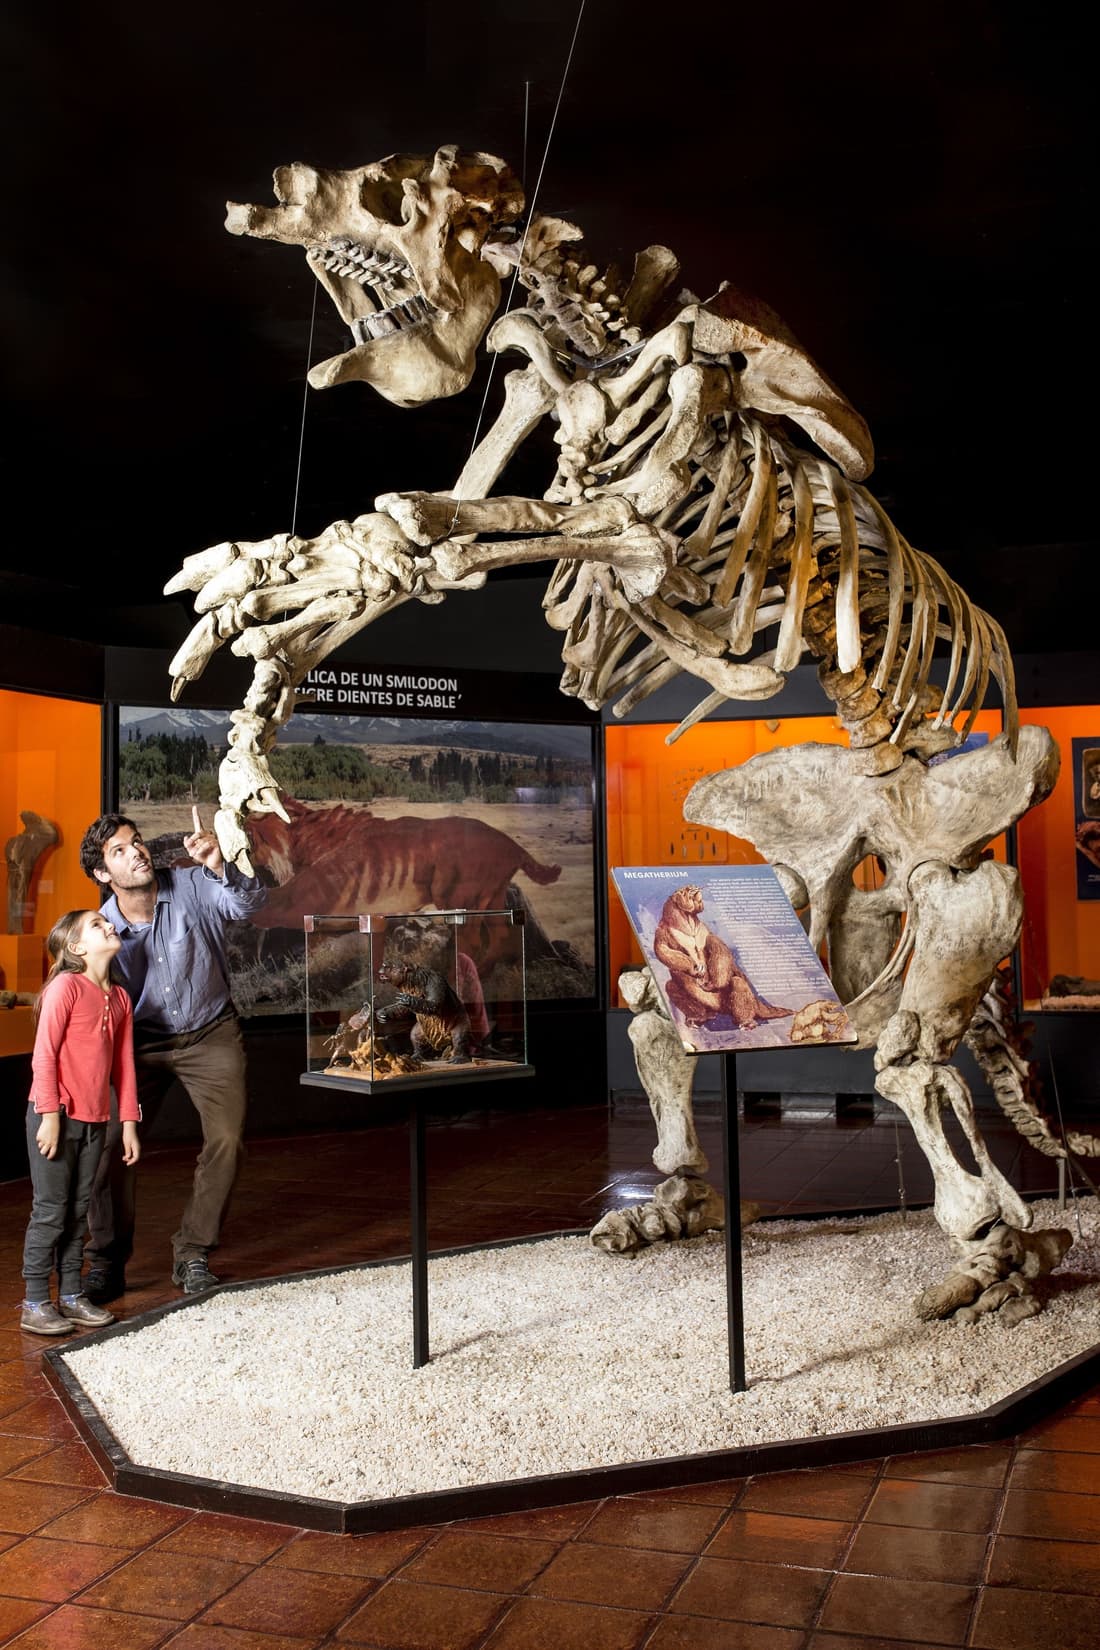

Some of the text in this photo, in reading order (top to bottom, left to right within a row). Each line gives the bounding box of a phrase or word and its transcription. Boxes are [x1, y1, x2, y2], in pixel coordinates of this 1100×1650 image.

[306, 670, 457, 691] LICA DE UN SMILODON
[337, 689, 393, 705] DIENTES
[396, 692, 414, 706] DE
[623, 871, 689, 879] MEGATHERIUM
